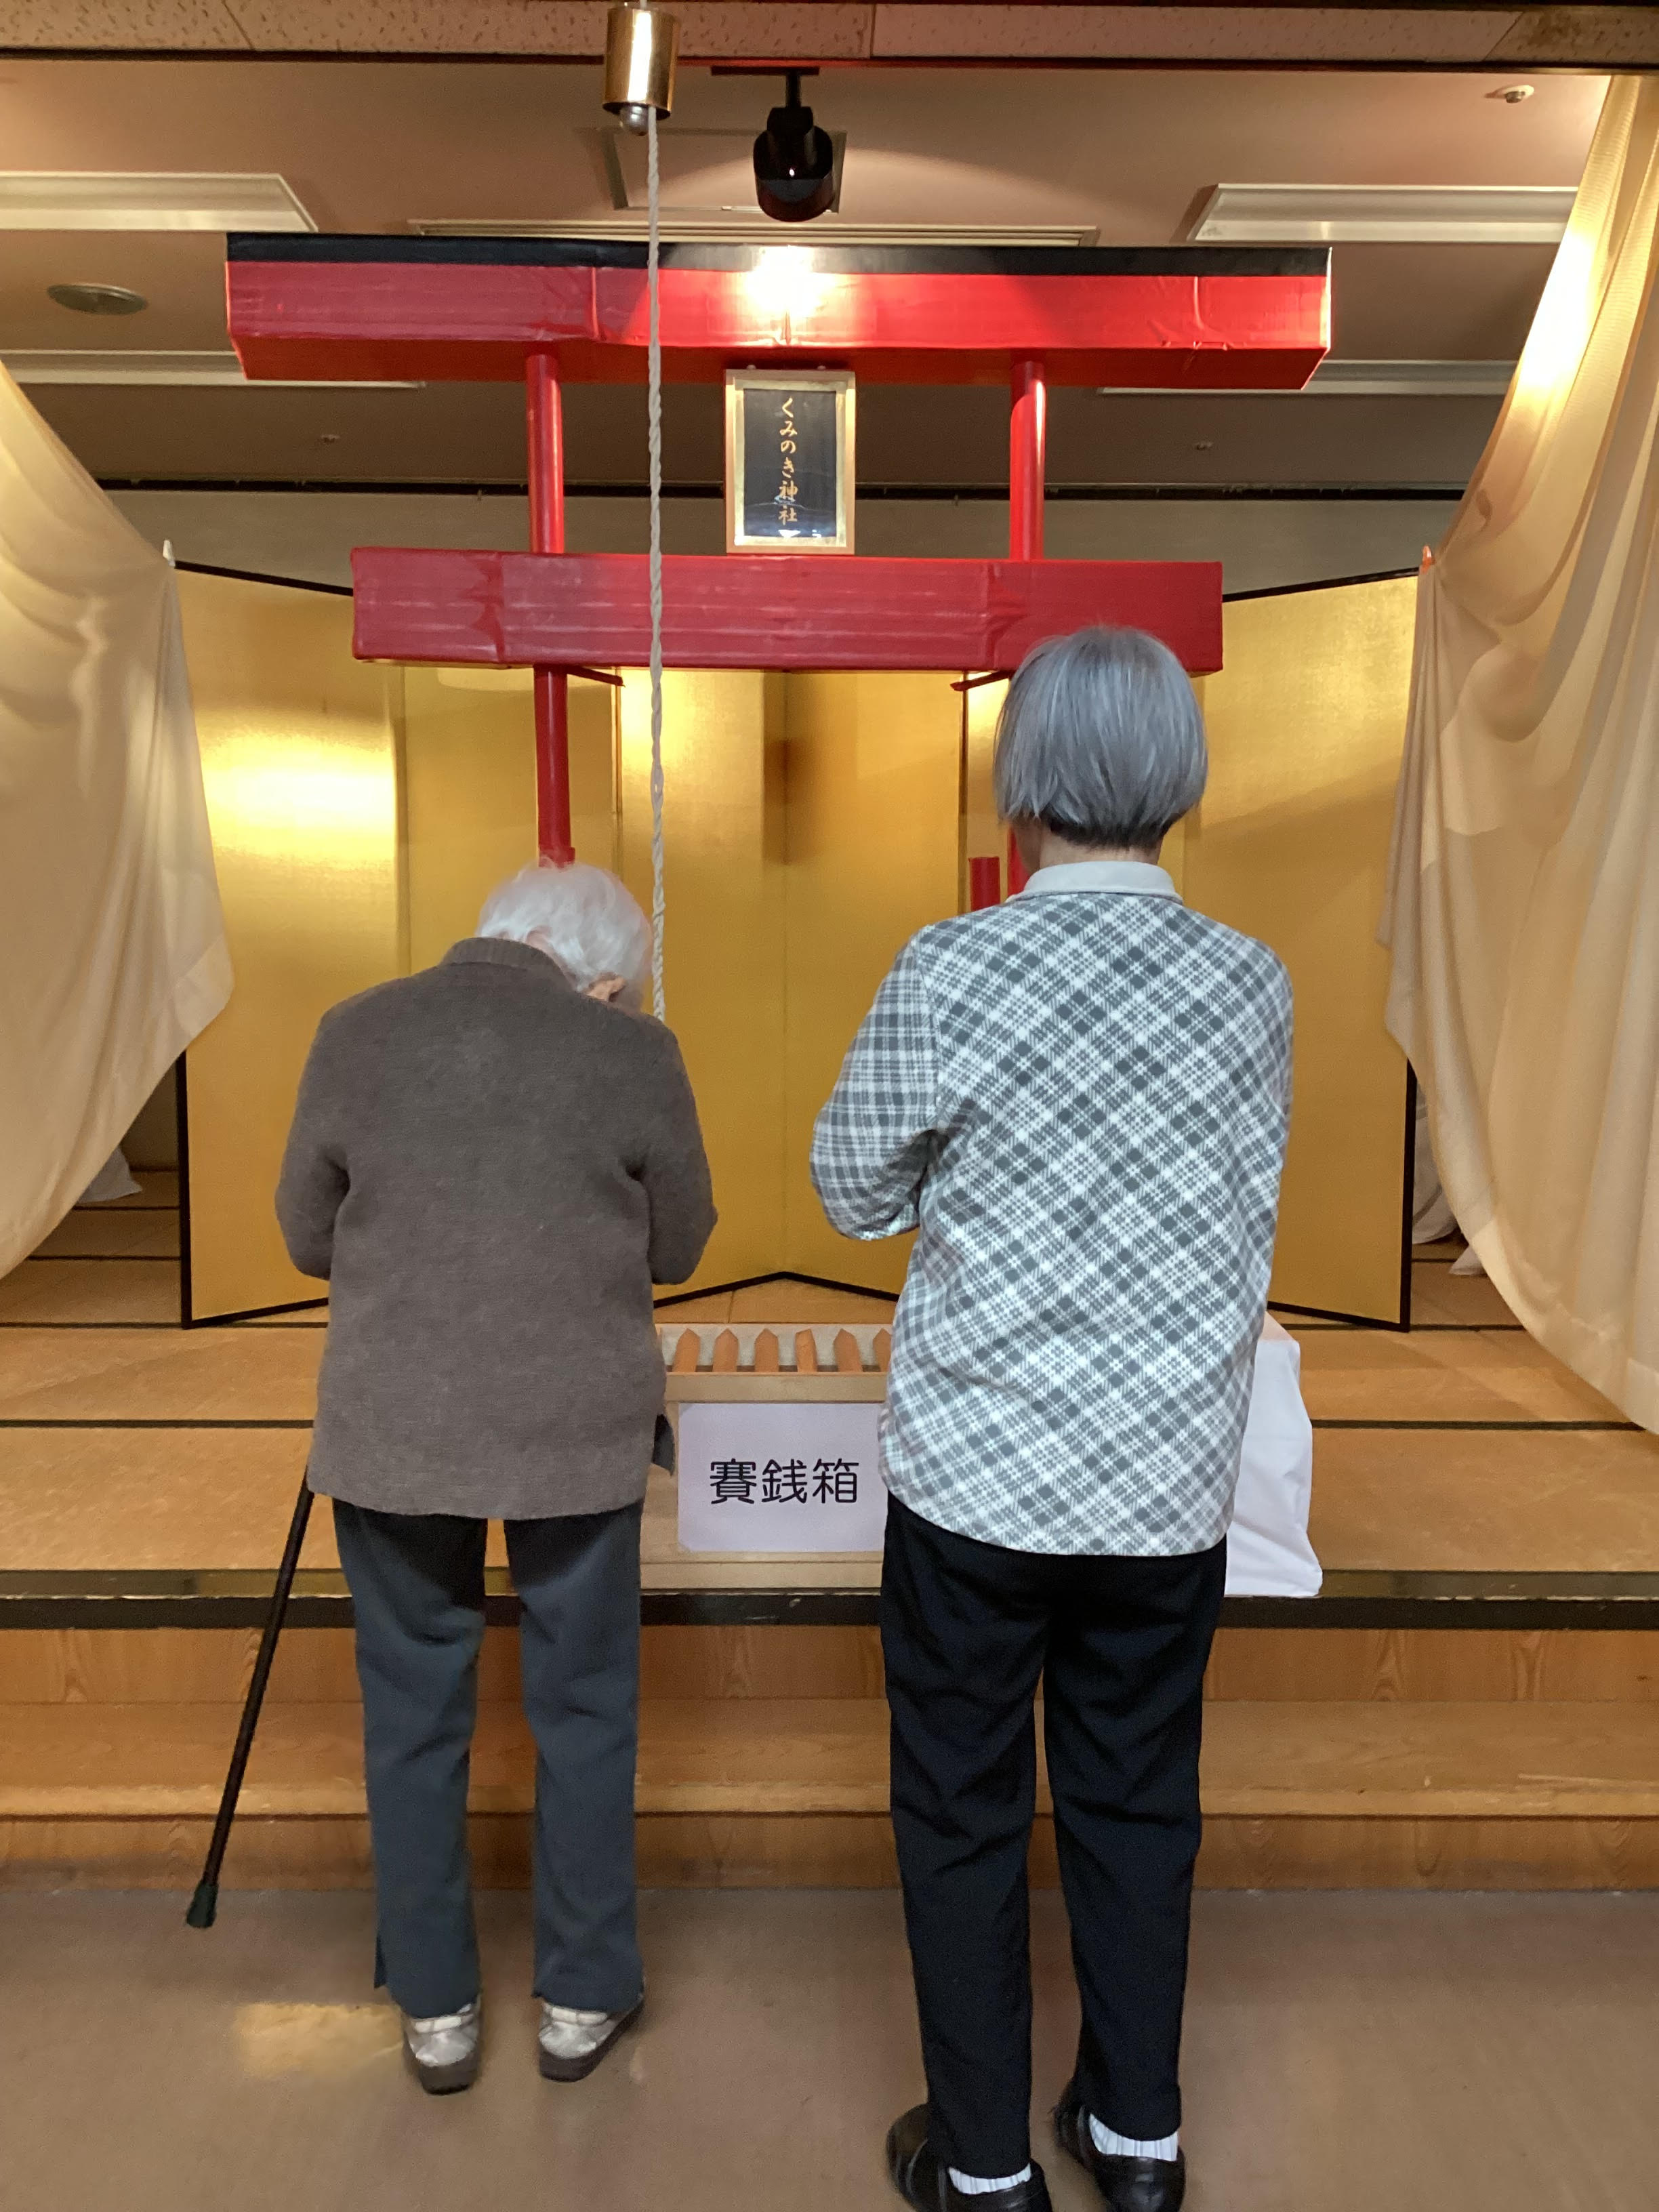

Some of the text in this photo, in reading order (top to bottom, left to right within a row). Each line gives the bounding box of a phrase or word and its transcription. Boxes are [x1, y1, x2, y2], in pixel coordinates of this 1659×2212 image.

[779, 396, 798, 525] くみのき神社
[710, 1458, 859, 1504] 賽銭箱
